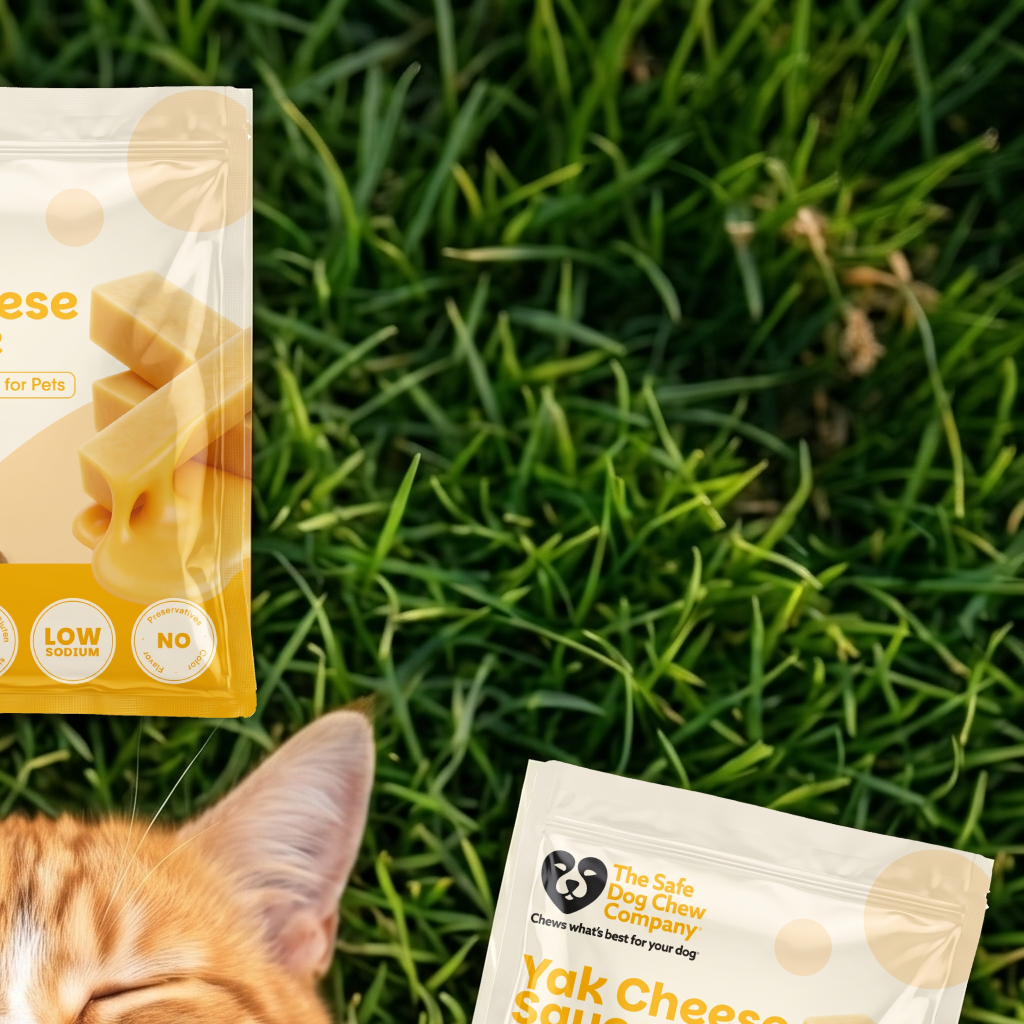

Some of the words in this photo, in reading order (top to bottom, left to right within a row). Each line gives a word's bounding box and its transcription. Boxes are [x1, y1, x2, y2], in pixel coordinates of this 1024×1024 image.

[5, 378, 26, 391] for
[32, 378, 65, 391] Pets
[146, 607, 202, 625] Preservatives
[45, 628, 101, 645] LOW
[158, 633, 190, 648] NO
[46, 648, 99, 656] SODIUM
[188, 650, 207, 670] Color
[143, 652, 164, 673] Flavor
[613, 863, 649, 888] The
[652, 873, 694, 898] Safe
[607, 883, 647, 912] Dog
[651, 893, 707, 920] Chew
[531, 913, 567, 930] Chews
[604, 928, 629, 943] best
[630, 934, 647, 947] for
[648, 941, 674, 953] your
[523, 954, 608, 1005] Yak
